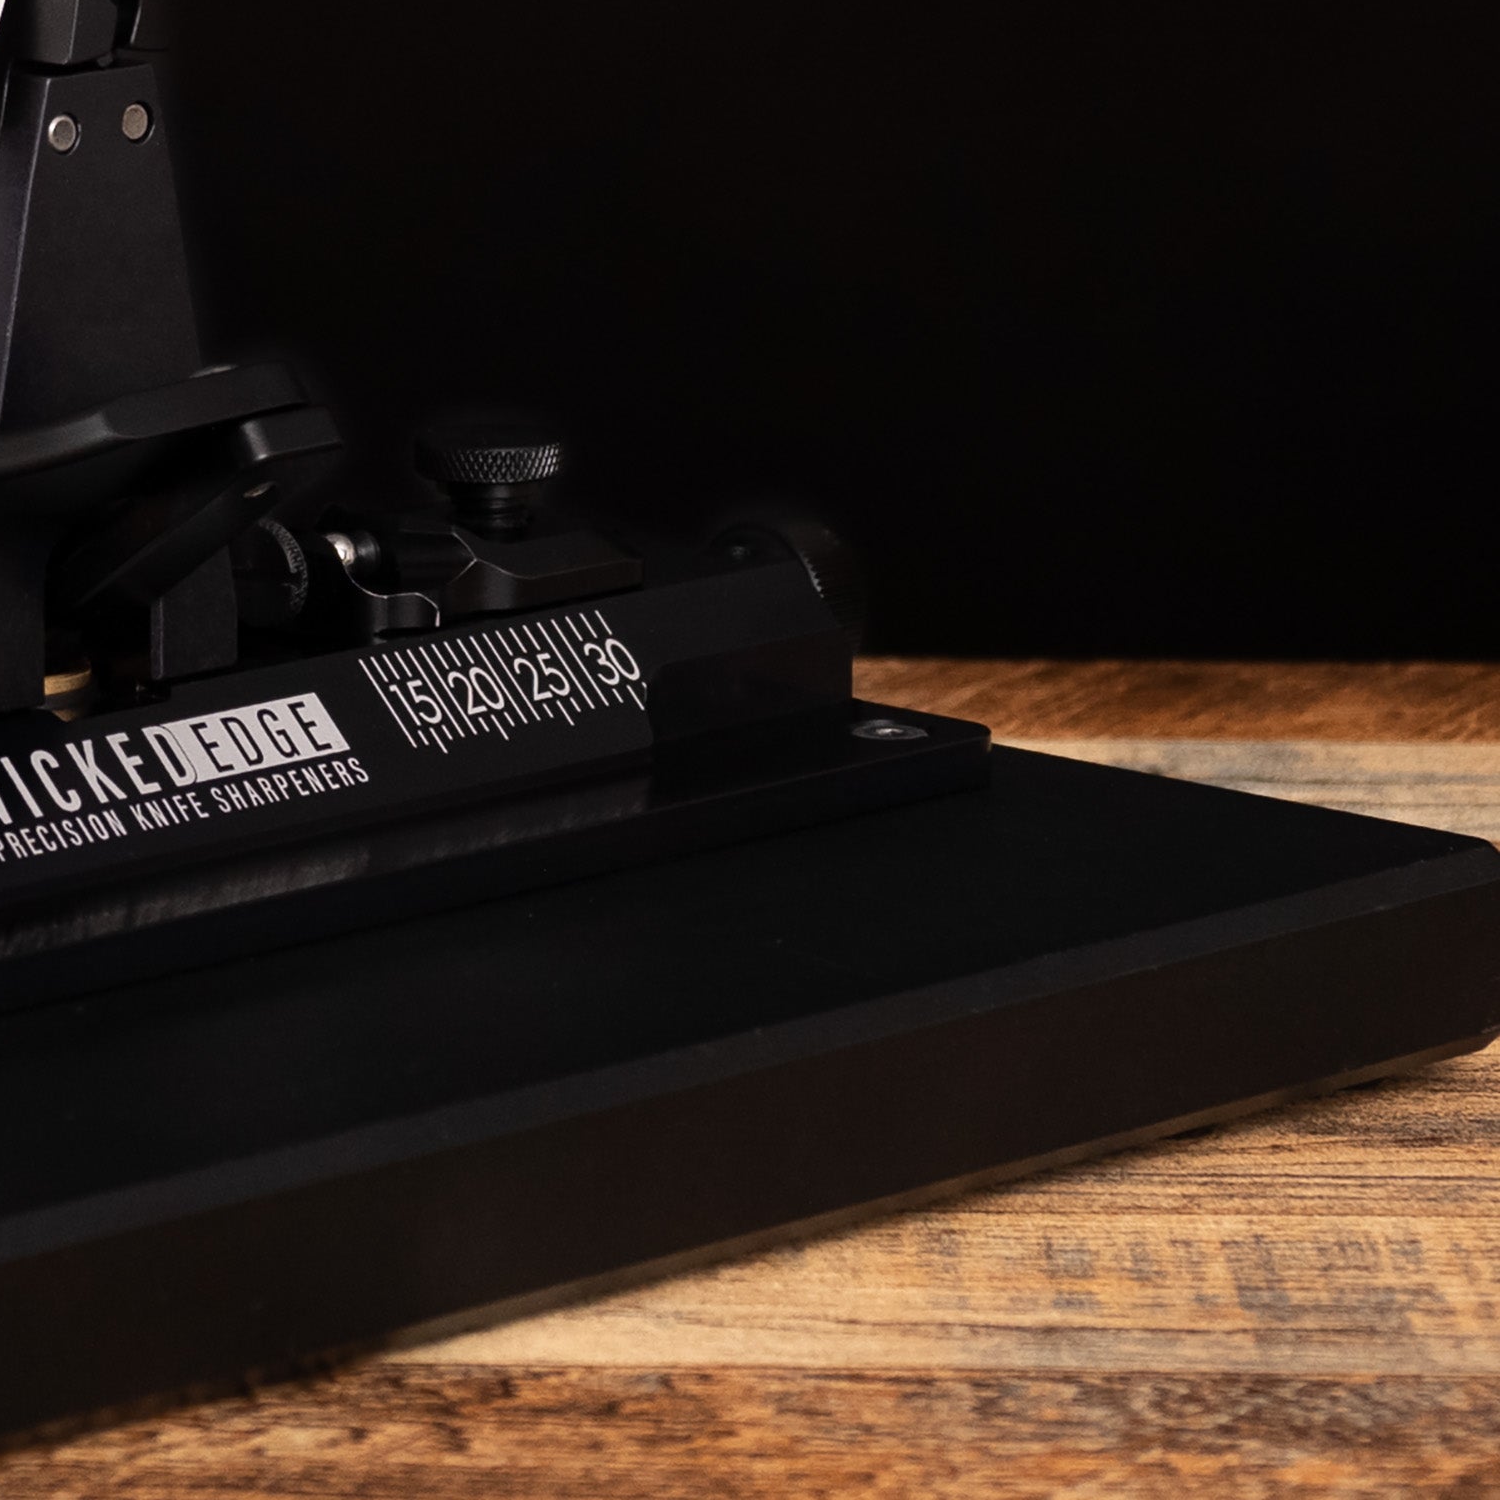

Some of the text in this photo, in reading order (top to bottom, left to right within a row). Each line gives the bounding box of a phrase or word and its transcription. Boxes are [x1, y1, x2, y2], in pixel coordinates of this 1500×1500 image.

[389, 638, 641, 726] 15 20 25 30
[130, 791, 210, 832] KNIFE
[211, 757, 370, 813] SHARPENERS
